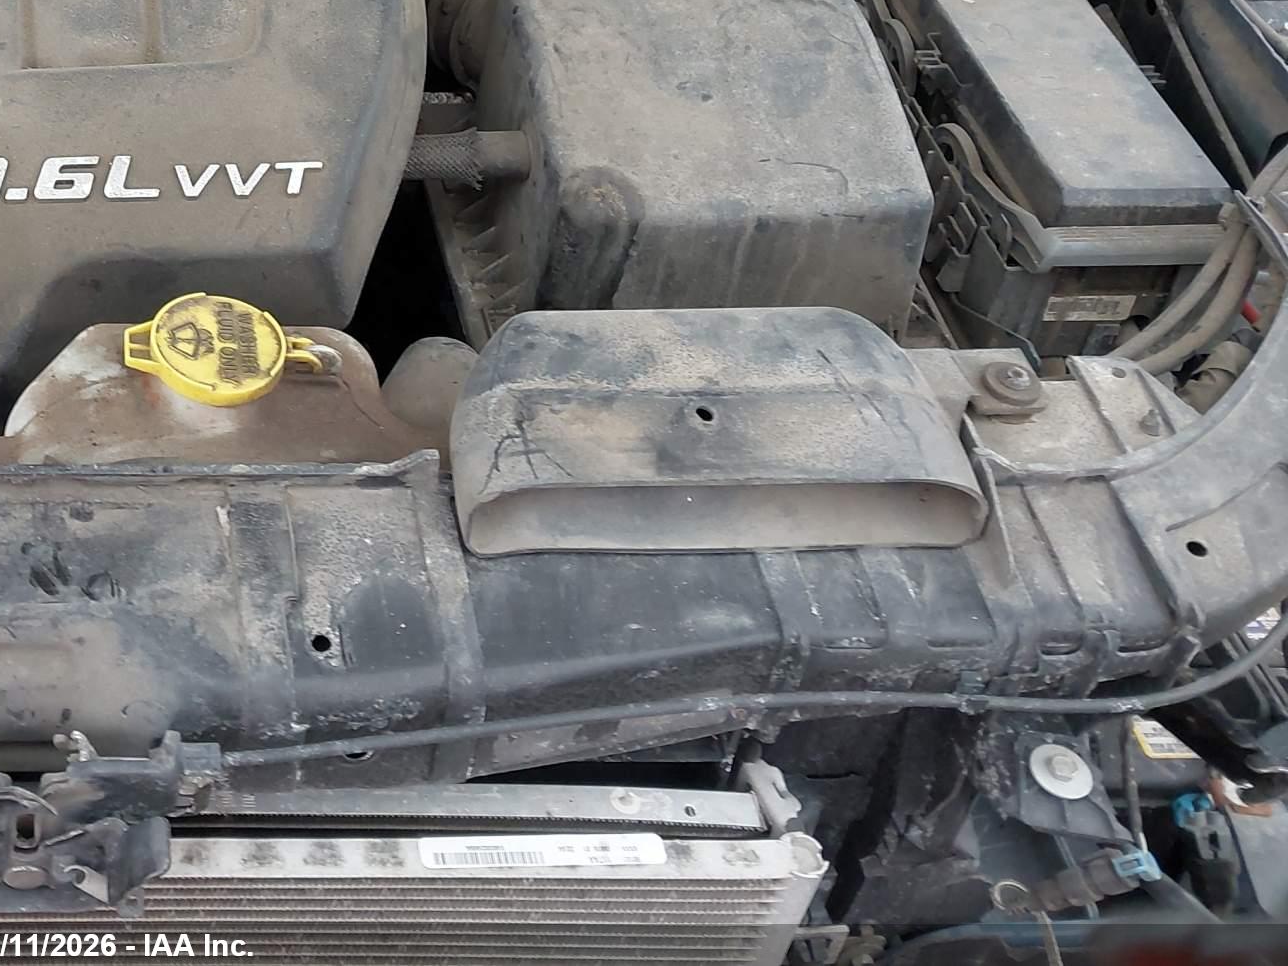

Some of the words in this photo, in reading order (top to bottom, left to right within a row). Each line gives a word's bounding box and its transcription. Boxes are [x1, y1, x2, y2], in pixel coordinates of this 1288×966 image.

[173, 160, 324, 199] VVT
[214, 301, 233, 344] FLUID
[236, 313, 260, 376] WASHER
[219, 346, 243, 388] ONLY
